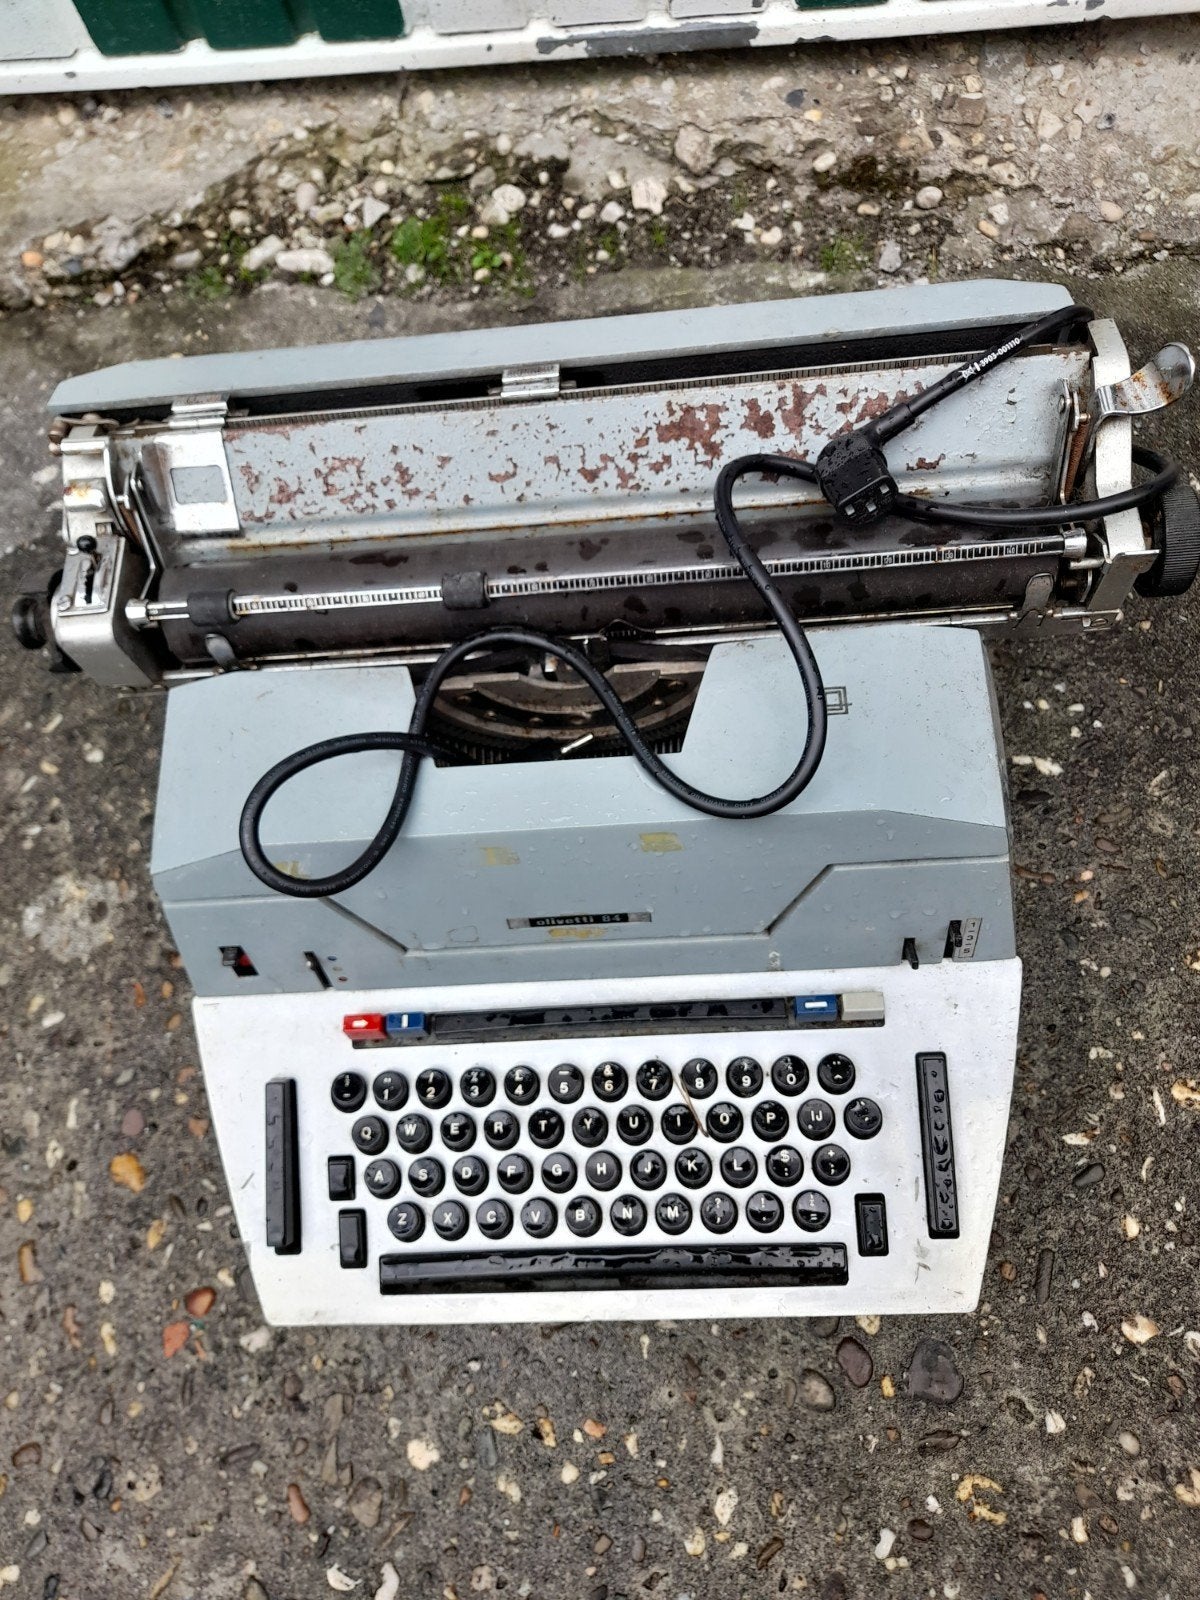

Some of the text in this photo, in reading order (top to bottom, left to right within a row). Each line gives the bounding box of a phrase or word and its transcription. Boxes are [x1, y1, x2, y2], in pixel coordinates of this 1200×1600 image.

[980, 337, 1021, 367] 3903-001110
[535, 913, 622, 926] olivetti 84
[604, 1065, 613, 1076] &
[384, 1090, 388, 1100] 1
[426, 1087, 435, 1097] 2
[470, 1086, 479, 1097] 3
[515, 1084, 524, 1095] 4
[560, 1082, 568, 1092] 5
[605, 1080, 613, 1091] 6
[649, 1080, 657, 1090] 7
[695, 1078, 704, 1089] 8
[742, 1076, 750, 1087] 9
[362, 1127, 372, 1139] Q
[404, 1124, 417, 1135] W
[451, 1123, 459, 1134] E
[494, 1122, 503, 1134] R
[539, 1120, 547, 1131] T
[584, 1118, 592, 1129] Y
[629, 1116, 638, 1128] U
[720, 1113, 729, 1124] O
[767, 1113, 775, 1124] P
[374, 1170, 384, 1181] A
[418, 1170, 428, 1180] S
[462, 1167, 471, 1179] D
[507, 1166, 516, 1177] F
[552, 1165, 561, 1176] G
[597, 1163, 606, 1174] H
[645, 1162, 652, 1173] J
[687, 1160, 697, 1171] K
[734, 1159, 742, 1170] L
[780, 1151, 789, 1162] $
[398, 1213, 407, 1225] Z
[443, 1212, 452, 1223] X
[487, 1211, 496, 1222] C
[531, 1211, 540, 1222] V
[575, 1210, 585, 1220] B
[623, 1207, 632, 1219] N
[667, 1206, 679, 1217] M
[715, 1198, 721, 1208] ?
